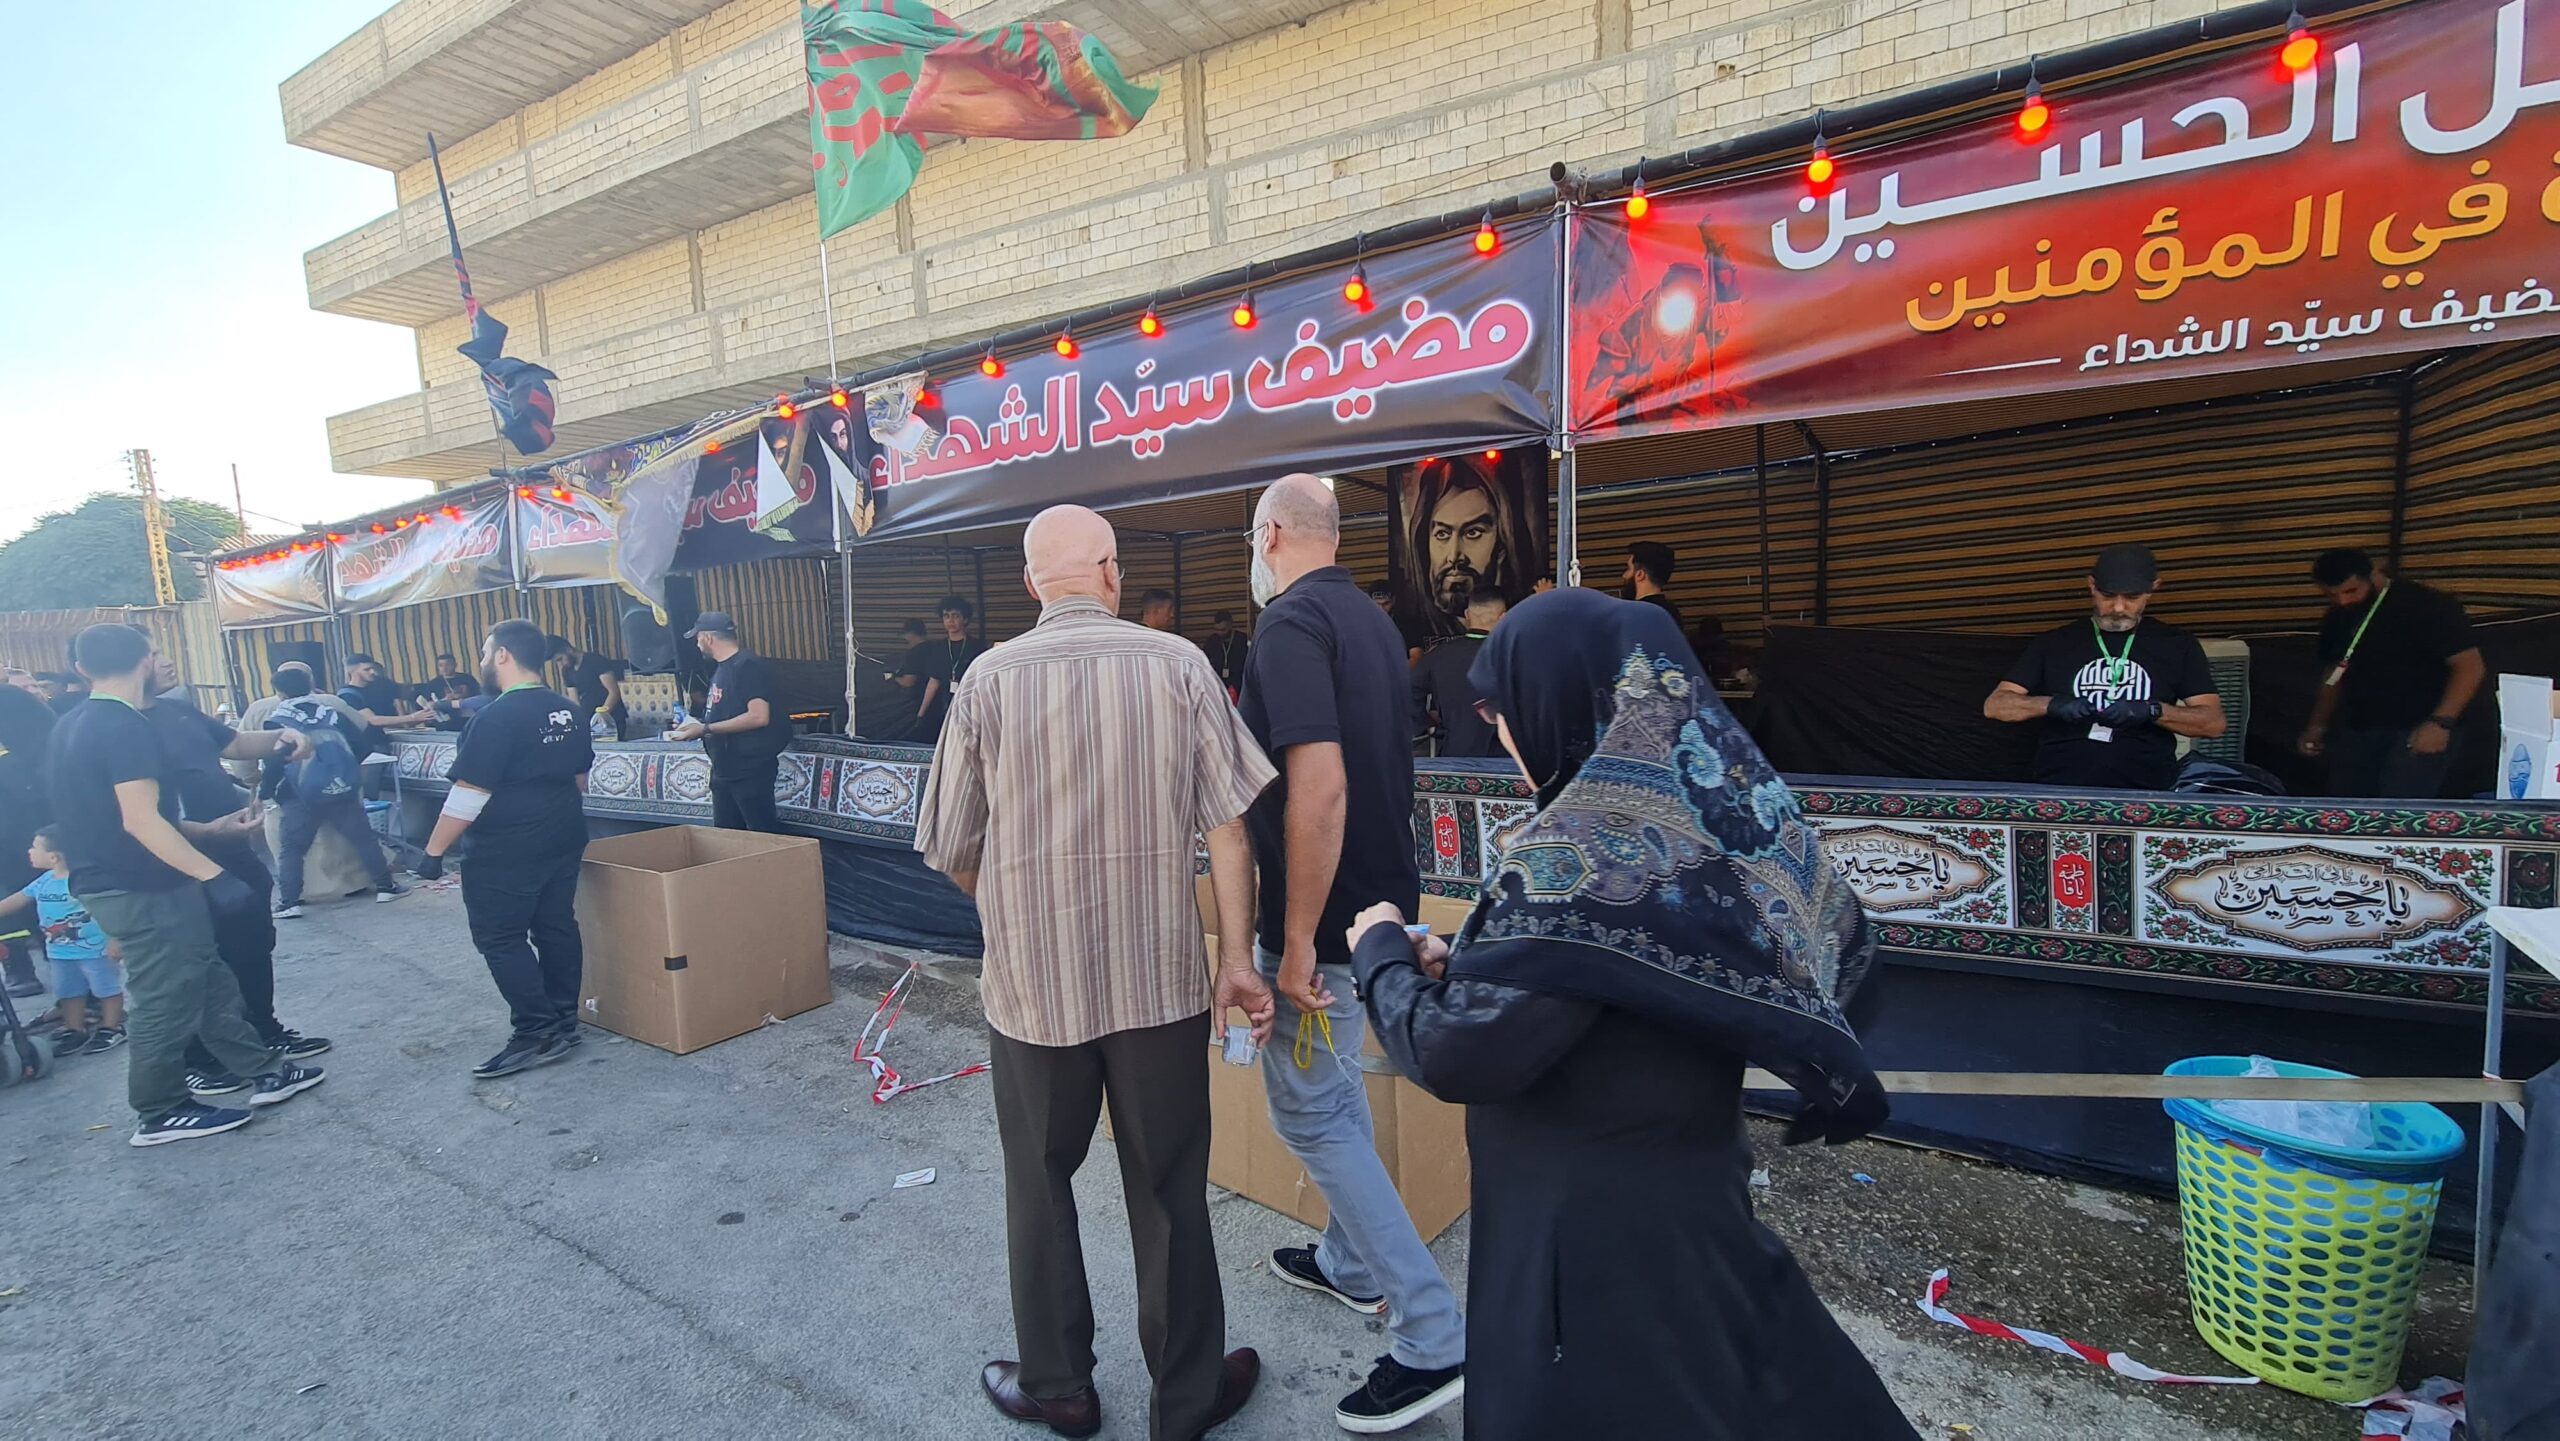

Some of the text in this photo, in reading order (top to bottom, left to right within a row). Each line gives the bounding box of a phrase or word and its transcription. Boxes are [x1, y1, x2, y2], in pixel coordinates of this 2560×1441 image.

[1770, 42, 2361, 270] الحسين
[1906, 190, 2344, 332] المؤمنين
[2369, 159, 2508, 289] في
[1247, 297, 1532, 421] مضيف
[2399, 278, 2560, 333] ضيف
